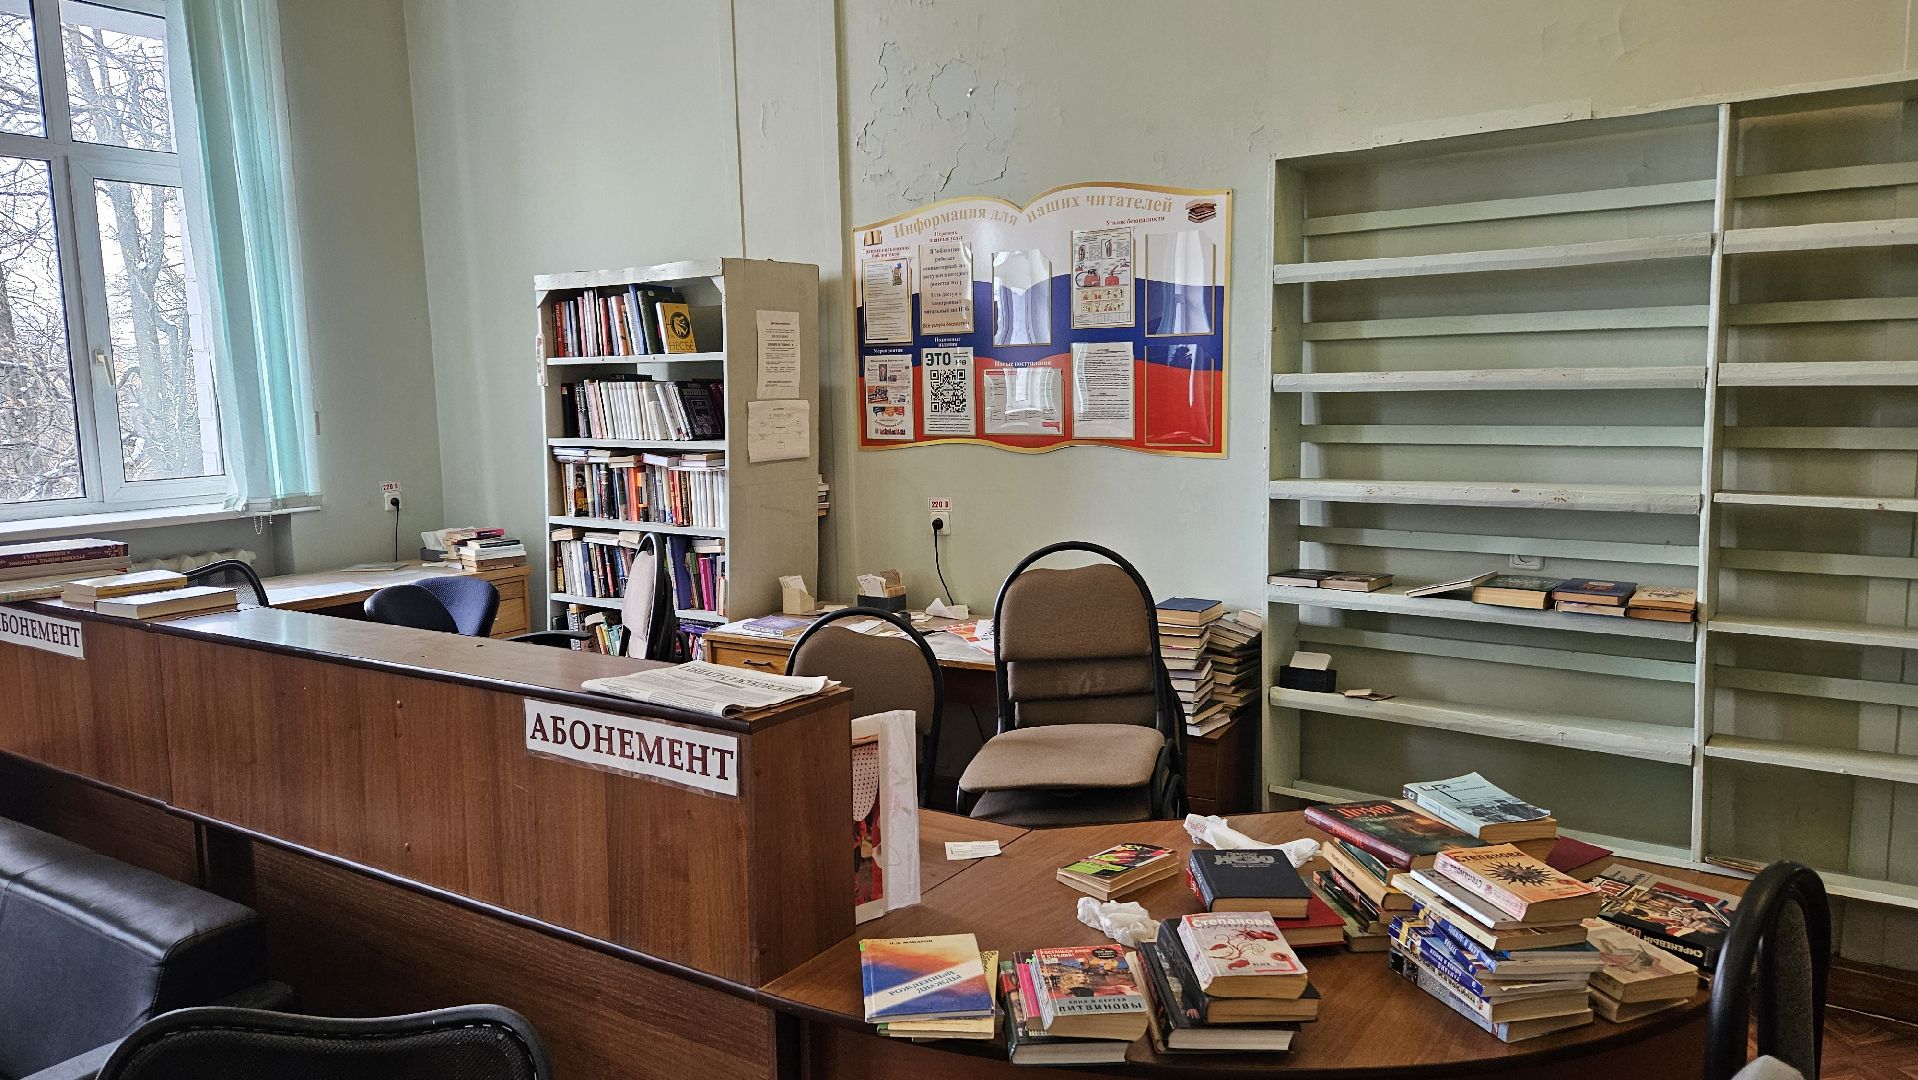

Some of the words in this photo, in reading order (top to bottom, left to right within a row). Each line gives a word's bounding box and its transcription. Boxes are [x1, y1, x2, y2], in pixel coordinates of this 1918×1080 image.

[894, 207, 986, 238] Информация
[991, 208, 1018, 226] для
[1026, 195, 1081, 223] наших
[1086, 195, 1174, 213] читателей
[925, 352, 951, 367] ЭТО
[931, 500, 943, 508] 220
[0, 612, 80, 648] БОНЕМЕНТ
[529, 711, 735, 781] АБОНЕМЕНТ
[1643, 934, 1704, 958] СИРЕНЕВЫЙ
[888, 970, 955, 996] РОЖДЕННЫЙ
[917, 974, 962, 993] ДВАЖДЫ
[1059, 1002, 1142, 1013] ЛИТВИНОВЫ
